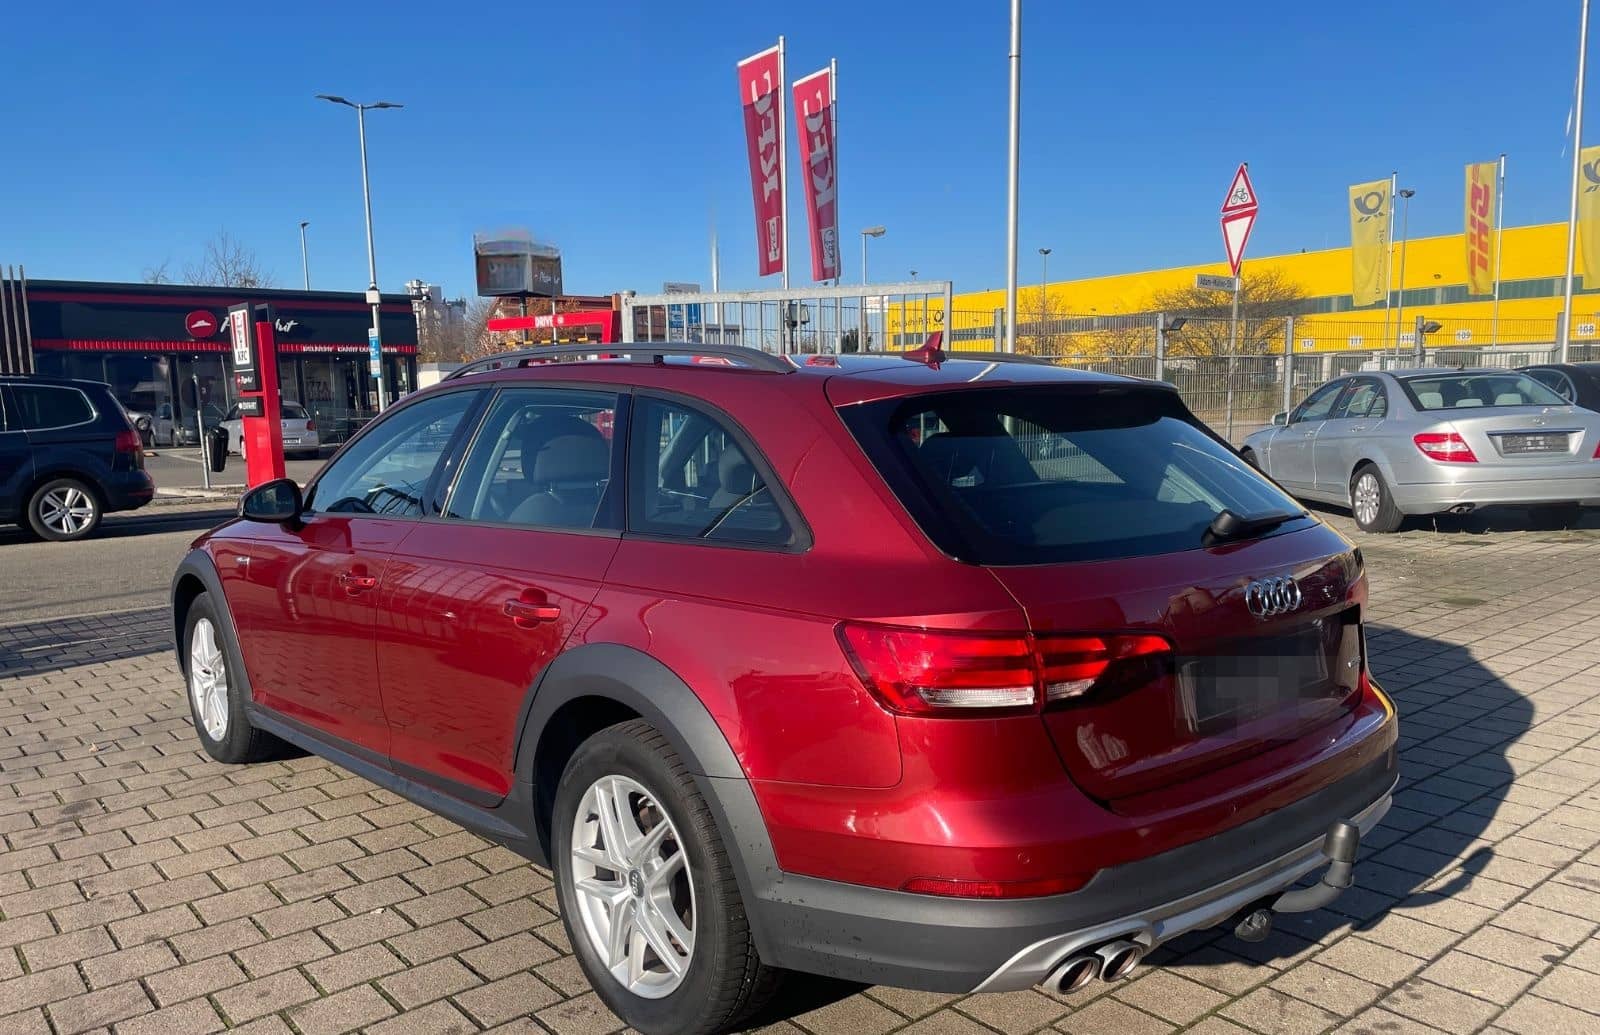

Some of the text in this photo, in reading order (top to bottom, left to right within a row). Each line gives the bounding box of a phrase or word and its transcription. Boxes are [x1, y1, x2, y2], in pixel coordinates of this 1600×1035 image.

[751, 70, 777, 203] KFC
[803, 90, 833, 209] KFC
[1470, 183, 1489, 277] DHL
[237, 350, 248, 362] KFC
